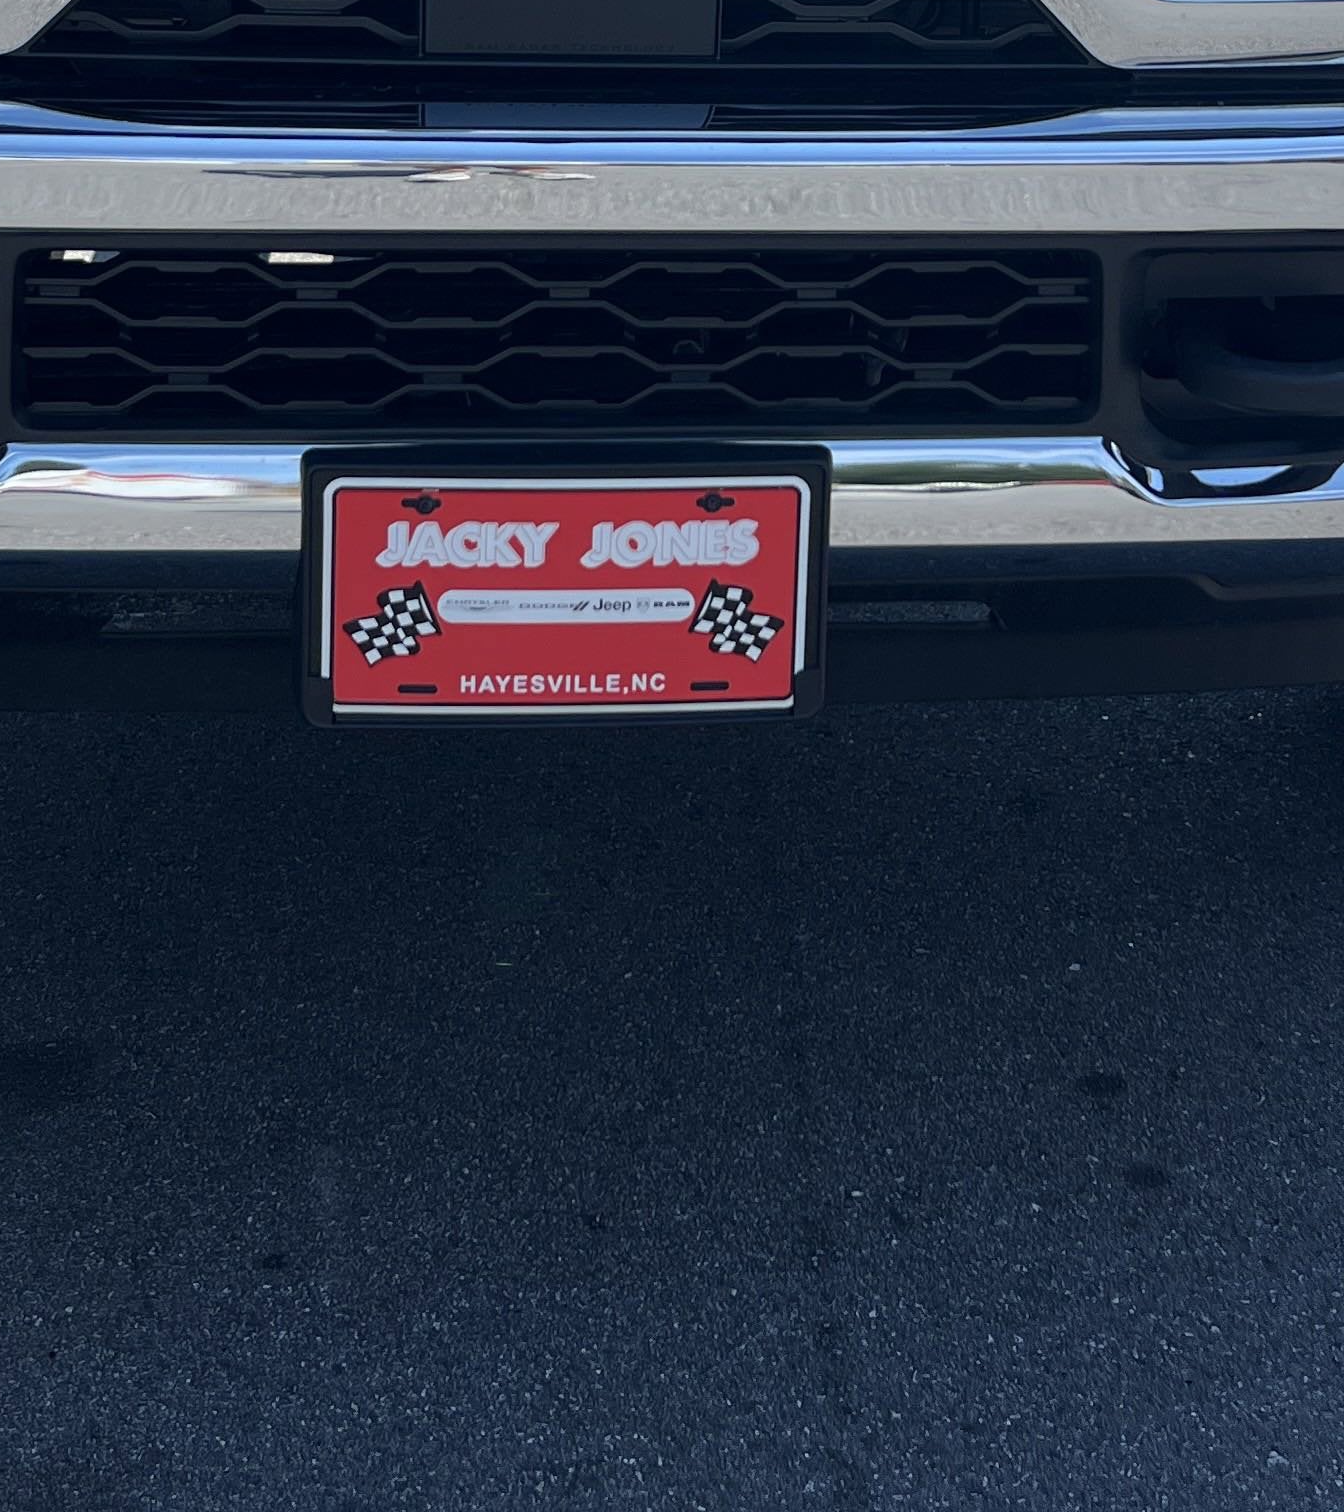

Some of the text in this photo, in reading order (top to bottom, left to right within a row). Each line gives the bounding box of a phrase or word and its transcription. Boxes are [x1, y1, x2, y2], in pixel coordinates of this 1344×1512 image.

[375, 518, 760, 569] JACKY JONES
[592, 598, 632, 612] Jeep
[653, 600, 691, 608] RAM
[460, 673, 667, 696] HAYESVILLE,NC
